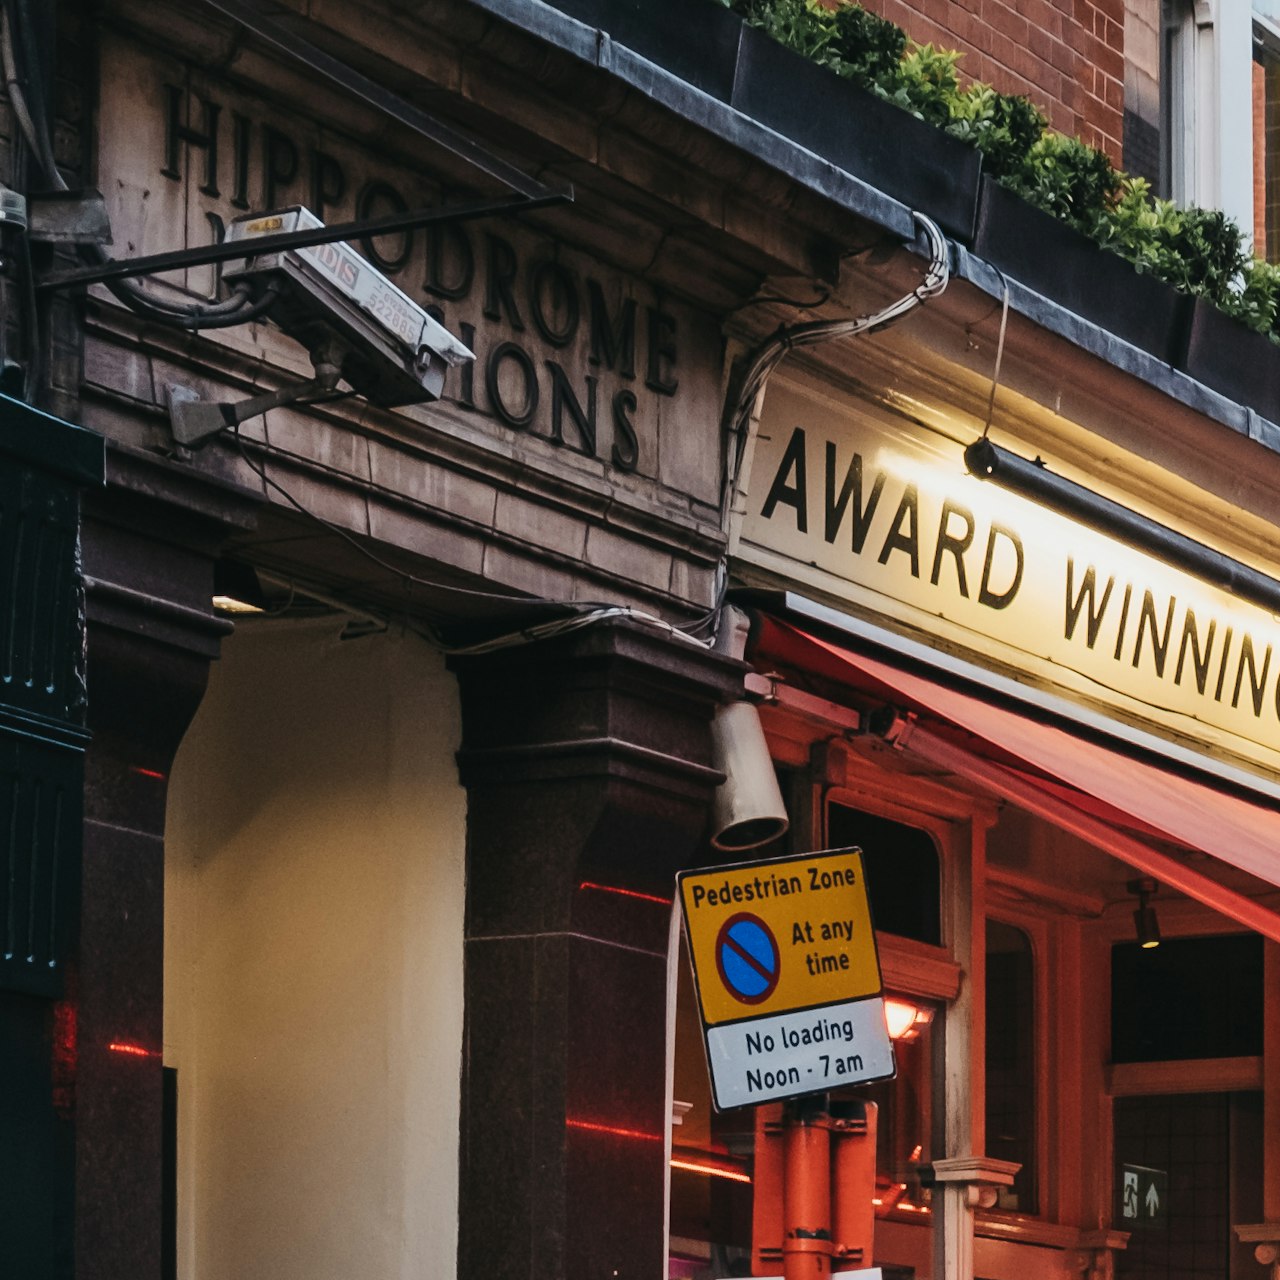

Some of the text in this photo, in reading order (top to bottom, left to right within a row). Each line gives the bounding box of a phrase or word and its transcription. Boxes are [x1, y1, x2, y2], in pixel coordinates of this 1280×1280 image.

[161, 85, 679, 396] HIPPODROME
[761, 428, 1024, 610] AWARD
[692, 867, 855, 908] Pedestrian Zone
[792, 920, 854, 945] At any
[805, 952, 850, 976] time
[745, 1018, 854, 1055] No loading
[746, 1065, 800, 1093] Noon
